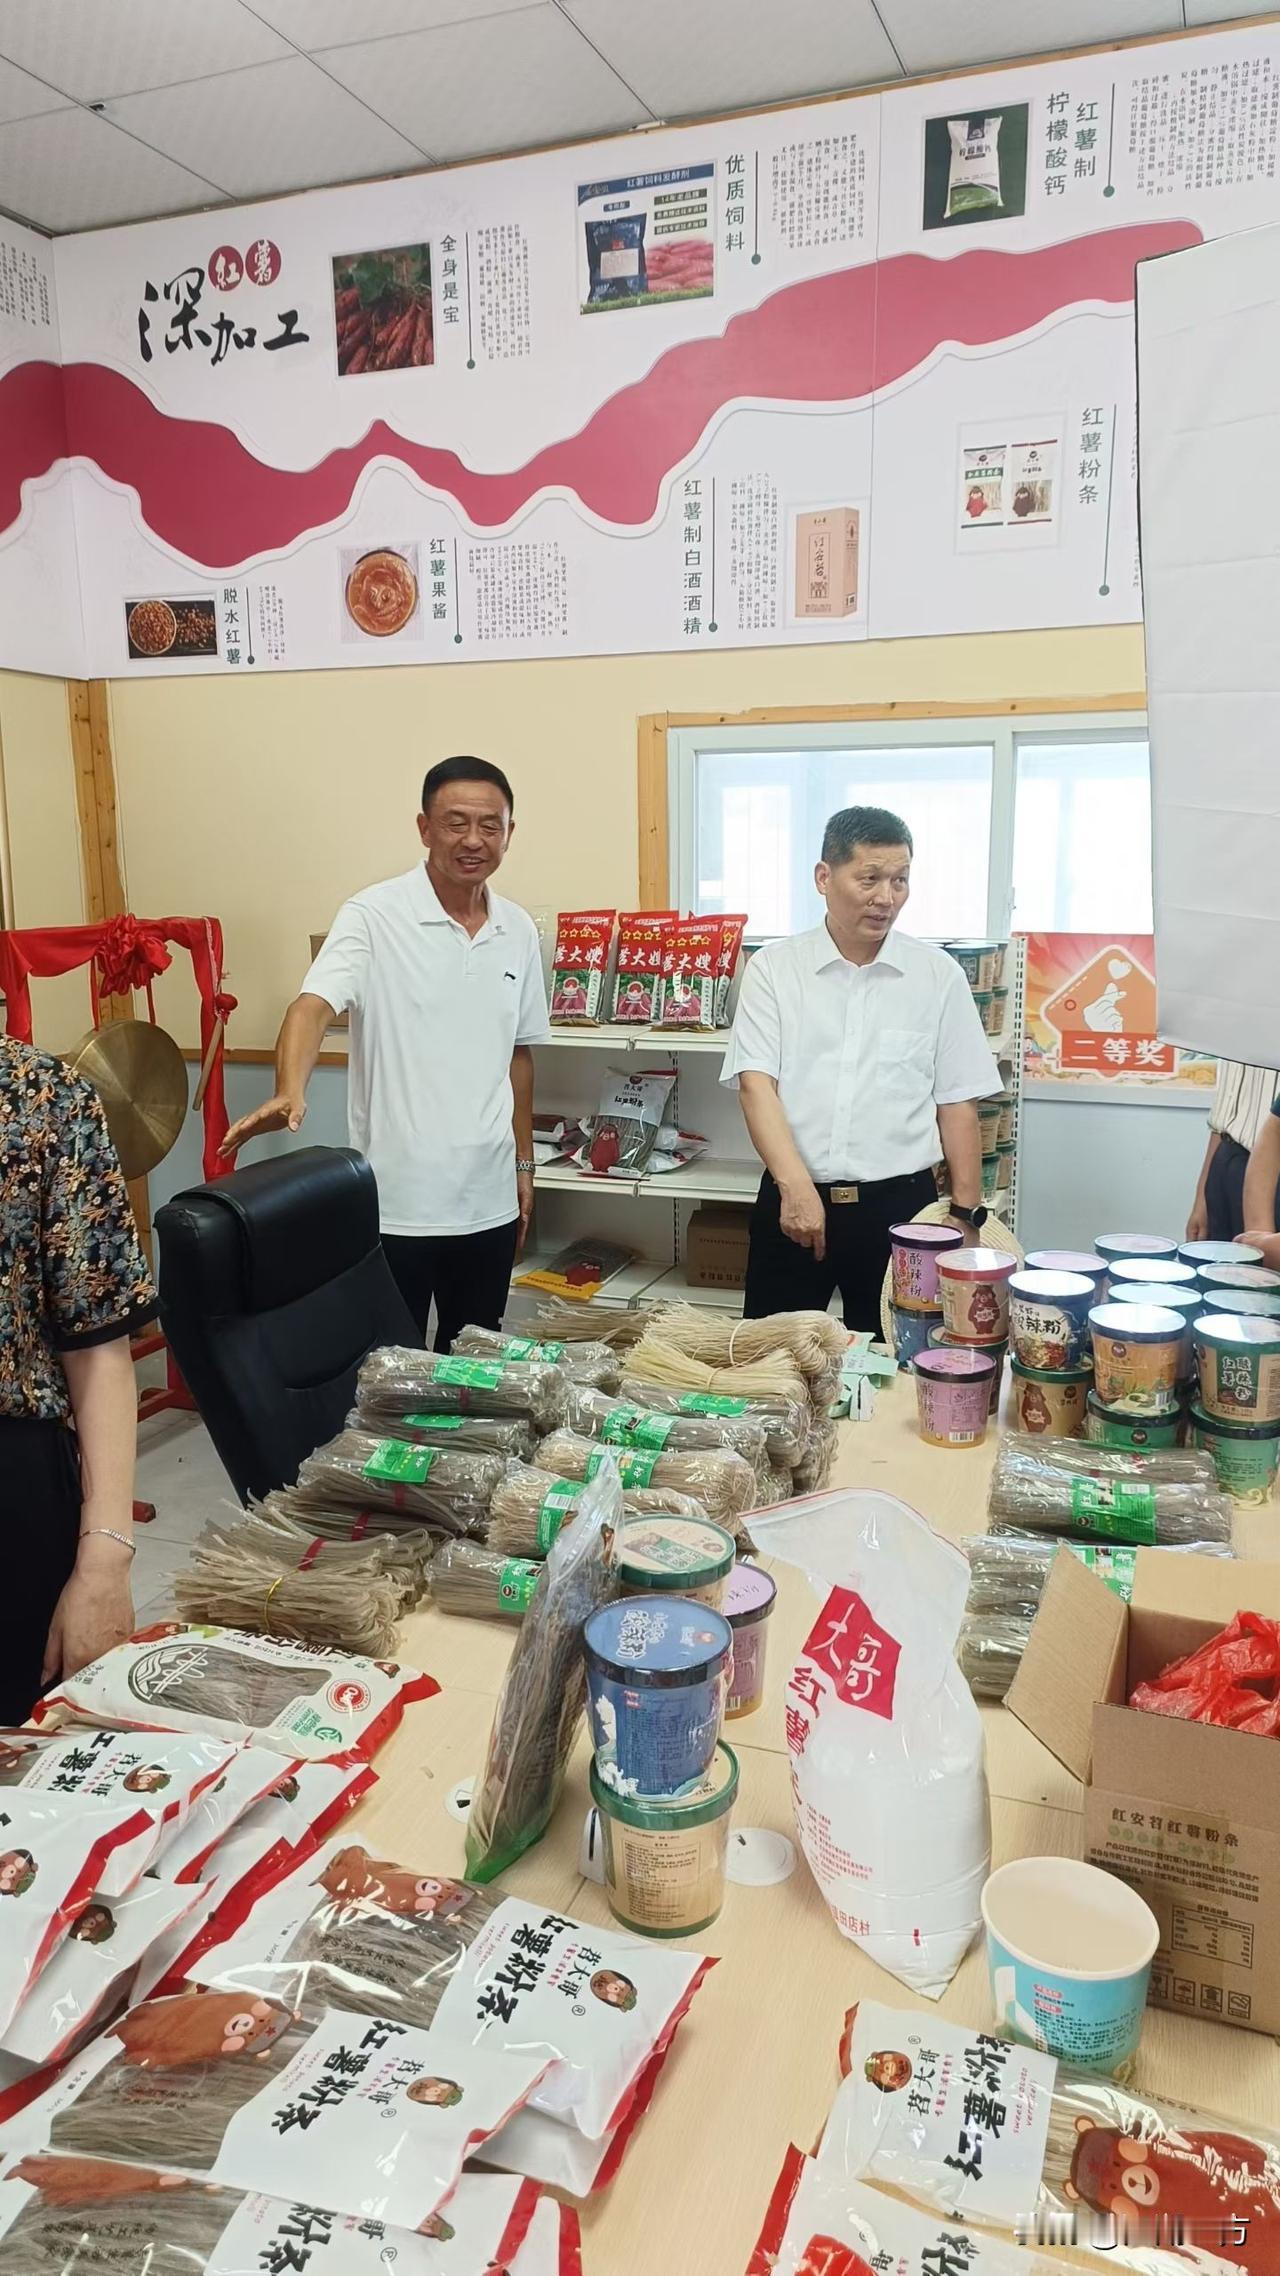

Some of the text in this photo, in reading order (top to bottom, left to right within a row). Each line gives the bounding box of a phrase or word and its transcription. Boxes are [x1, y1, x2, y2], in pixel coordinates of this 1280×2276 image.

[1044, 91, 1070, 196] 柠檬酸钙
[1074, 102, 1099, 178] 红薯制
[725, 154, 745, 252] 优质饲料
[138, 267, 310, 366] 深加工
[441, 234, 460, 324] 全身是宝
[1078, 407, 1104, 505] 红薯粉条
[429, 538, 447, 620] 红薯果酱
[683, 479, 703, 635] 红薯制白酒酒精
[223, 587, 242, 665] 脱水红薯
[1071, 1037, 1166, 1067] 二等奖
[909, 1251, 923, 1297] 酸辣粉
[812, 1602, 883, 1702] 大哥
[476, 1914, 580, 2030] 红薯粉条
[557, 1946, 602, 2000] 苕大哥
[271, 2019, 409, 2136] 红薯粉条
[368, 2058, 426, 2106] 苕大哥
[908, 2048, 940, 2117] 苕大哥
